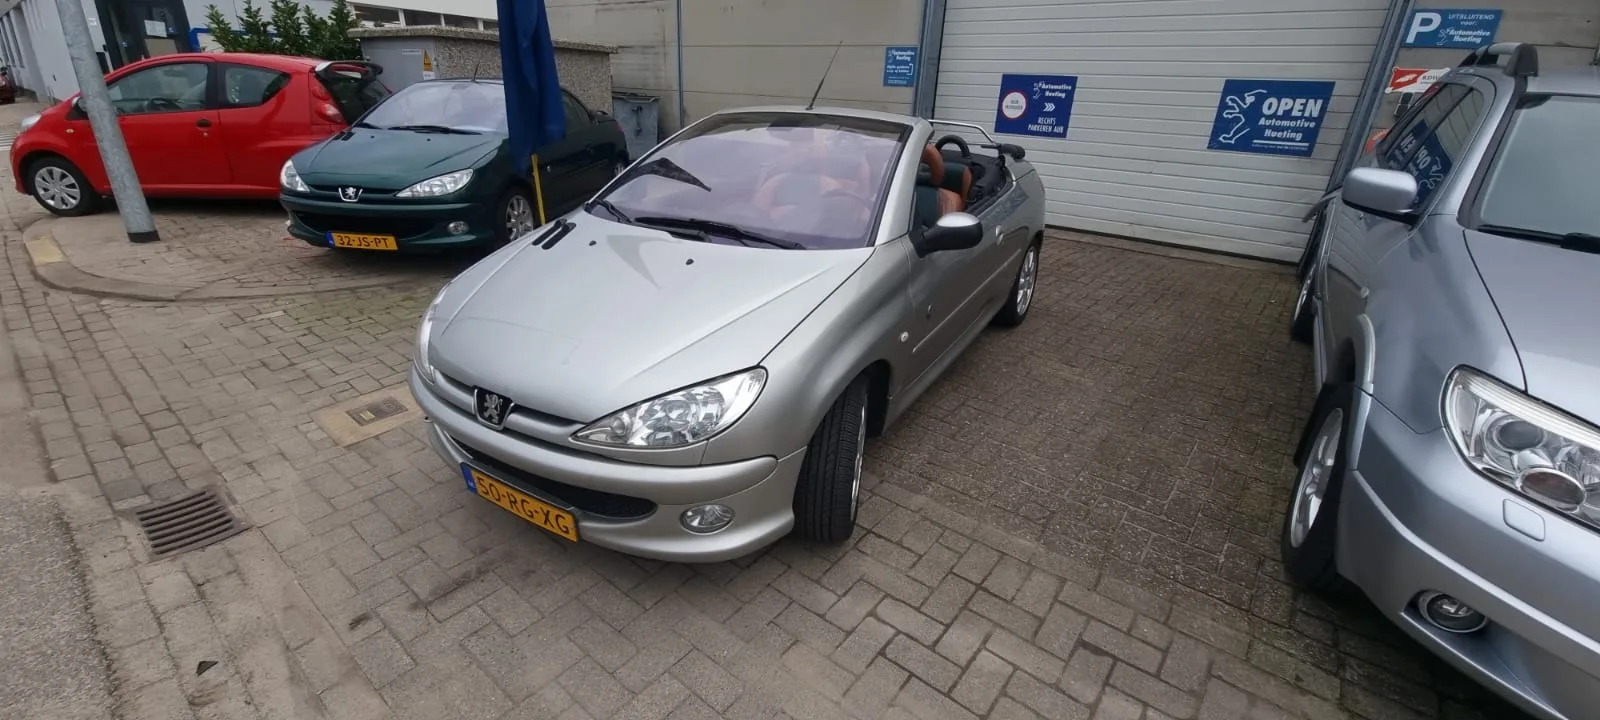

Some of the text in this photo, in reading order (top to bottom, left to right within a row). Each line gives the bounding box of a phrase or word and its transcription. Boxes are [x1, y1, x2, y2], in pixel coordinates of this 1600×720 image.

[1448, 13, 1495, 21] UITSLUITEND
[1405, 12, 1442, 44] P
[1449, 28, 1491, 36] Automotive
[1452, 35, 1483, 44] Hueting
[1262, 97, 1323, 118] OPEN
[1038, 117, 1056, 125] RECHTS
[1258, 117, 1317, 128] Automotive
[1027, 124, 1053, 133] PARKEREN
[1263, 129, 1303, 141] Hueting
[336, 234, 389, 249] 32-JS-PT
[476, 476, 570, 535] 50-RG-XG
